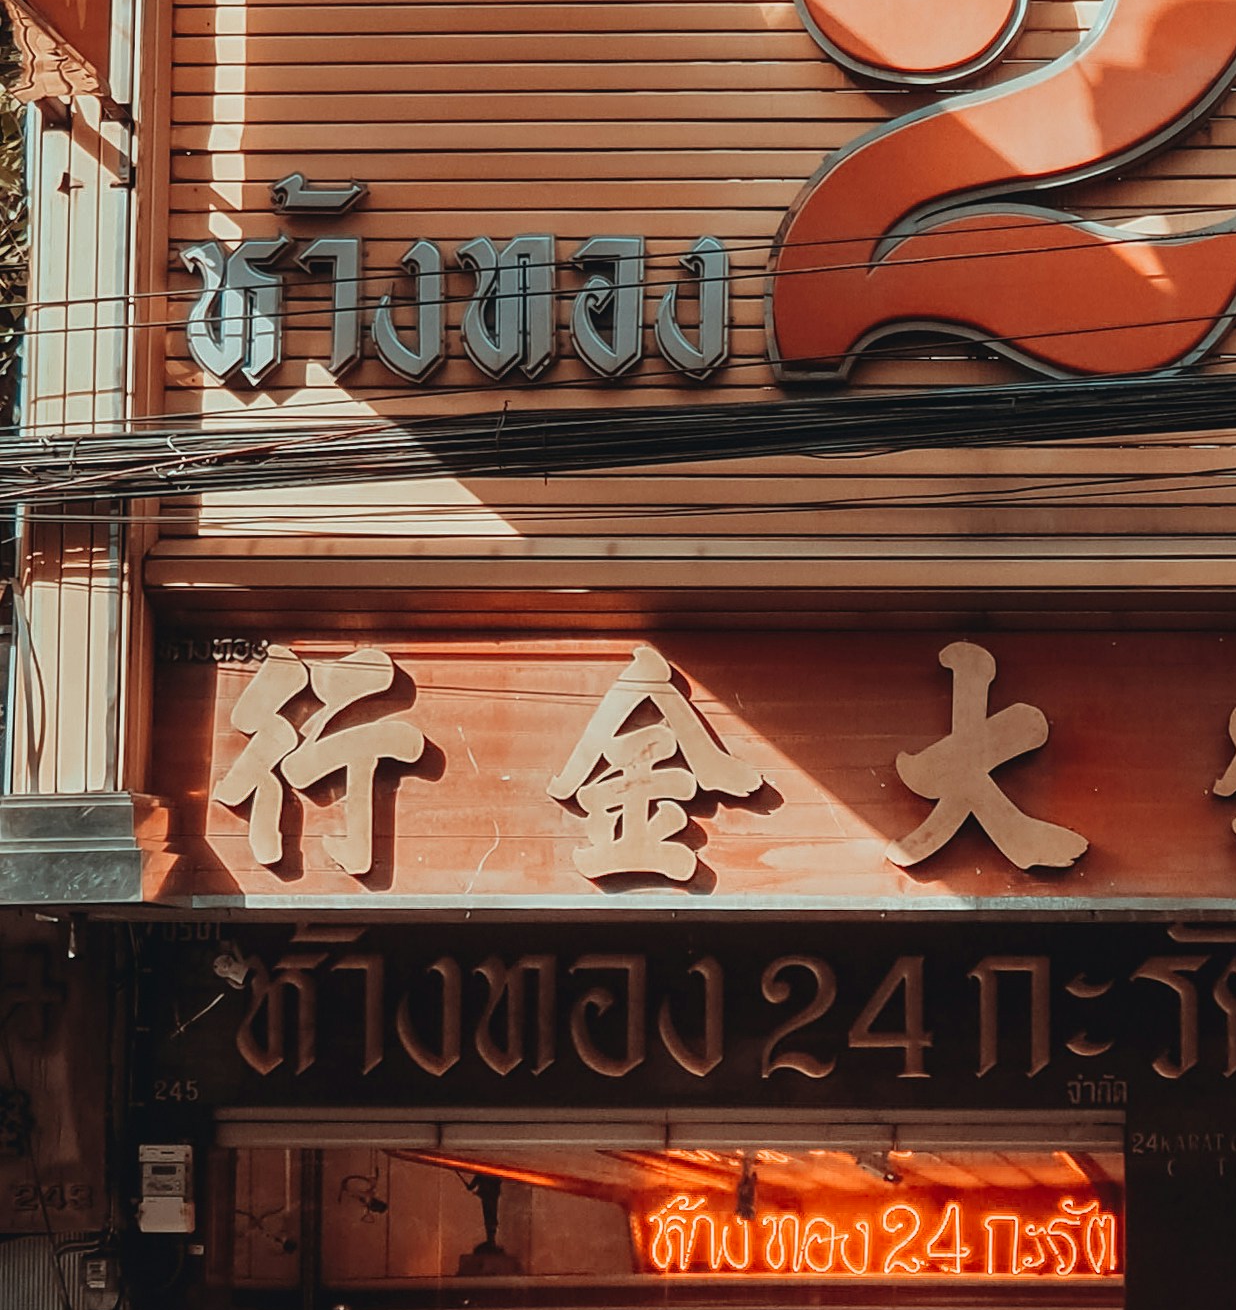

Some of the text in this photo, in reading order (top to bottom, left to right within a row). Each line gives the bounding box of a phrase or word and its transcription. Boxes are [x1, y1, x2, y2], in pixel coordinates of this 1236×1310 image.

[178, 171, 730, 386] ห้างทอง
[236, 924, 723, 1077] ห้างทอง
[761, 955, 933, 1080] 24
[154, 1079, 199, 1101] 245
[1067, 1074, 1128, 1104] จำกัด
[883, 1203, 971, 1274] 24
[983, 1197, 1118, 1275] กะรัต
